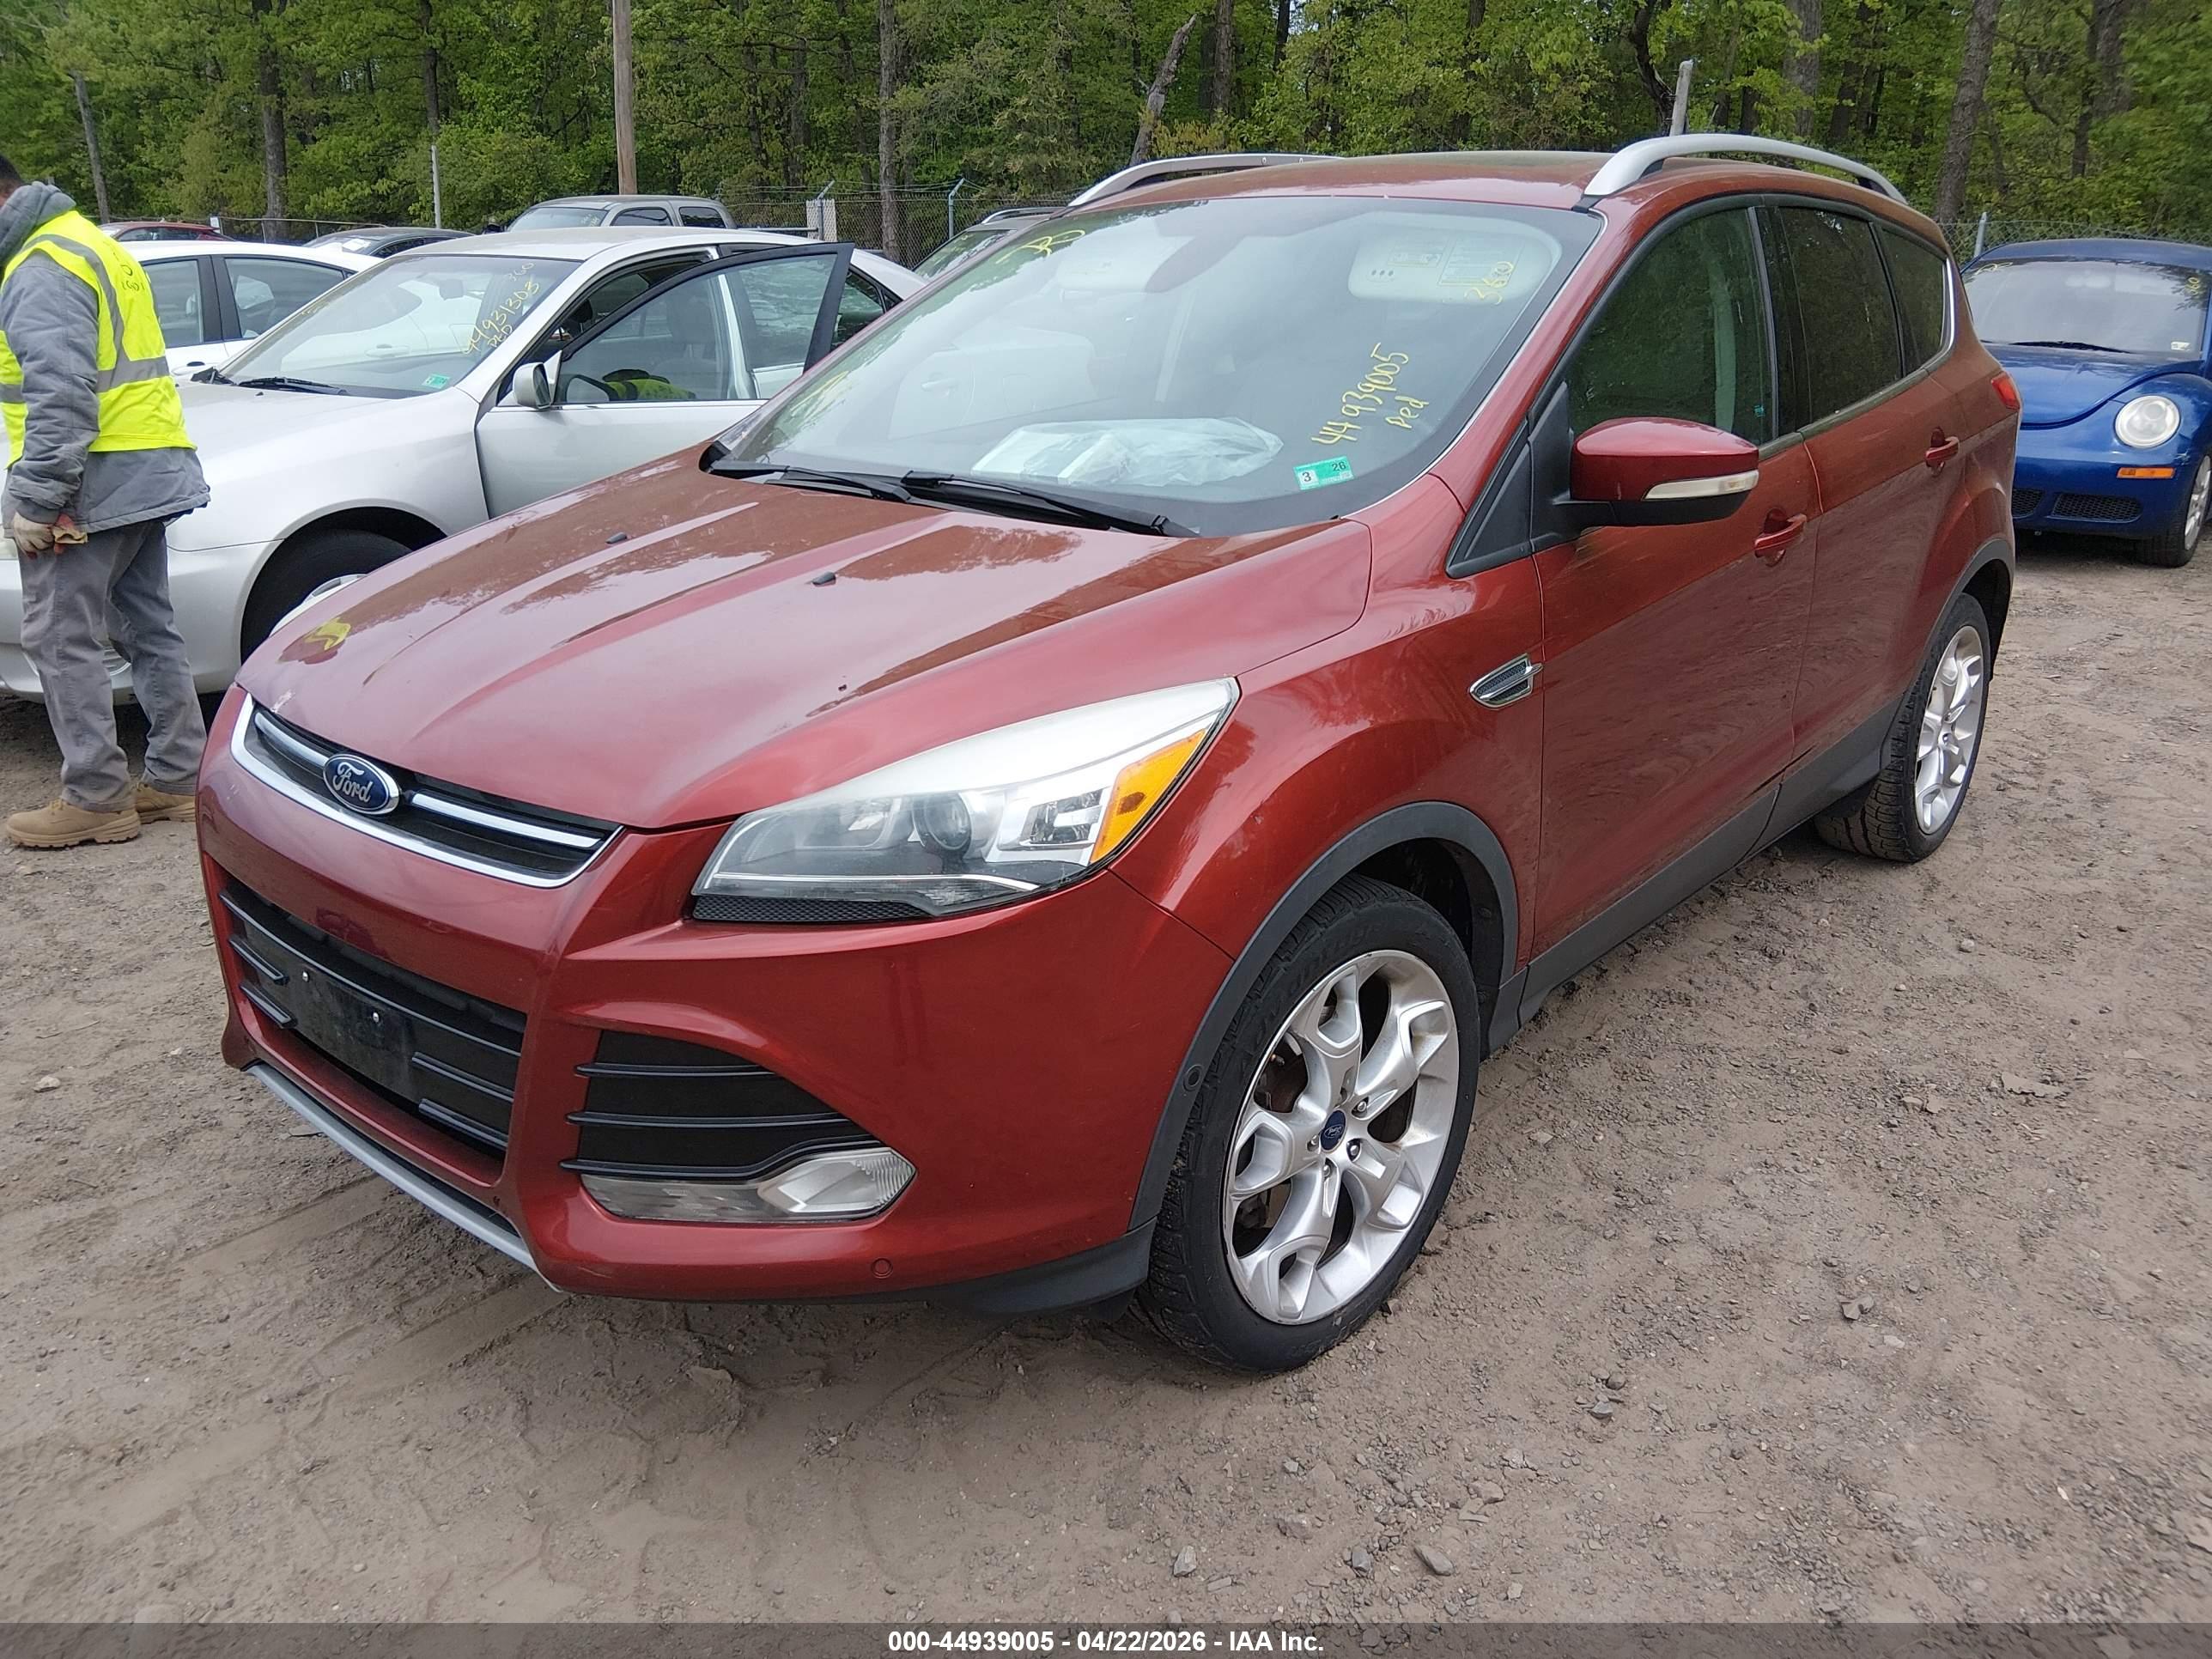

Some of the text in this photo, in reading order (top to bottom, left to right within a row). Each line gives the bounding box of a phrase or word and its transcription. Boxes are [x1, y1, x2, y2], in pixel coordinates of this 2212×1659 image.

[1464, 261, 1514, 305] 360
[1310, 342, 1409, 444] 44939005
[1302, 471, 1312, 483] 3
[1331, 461, 1346, 471] 26
[332, 762, 373, 802] Ford
